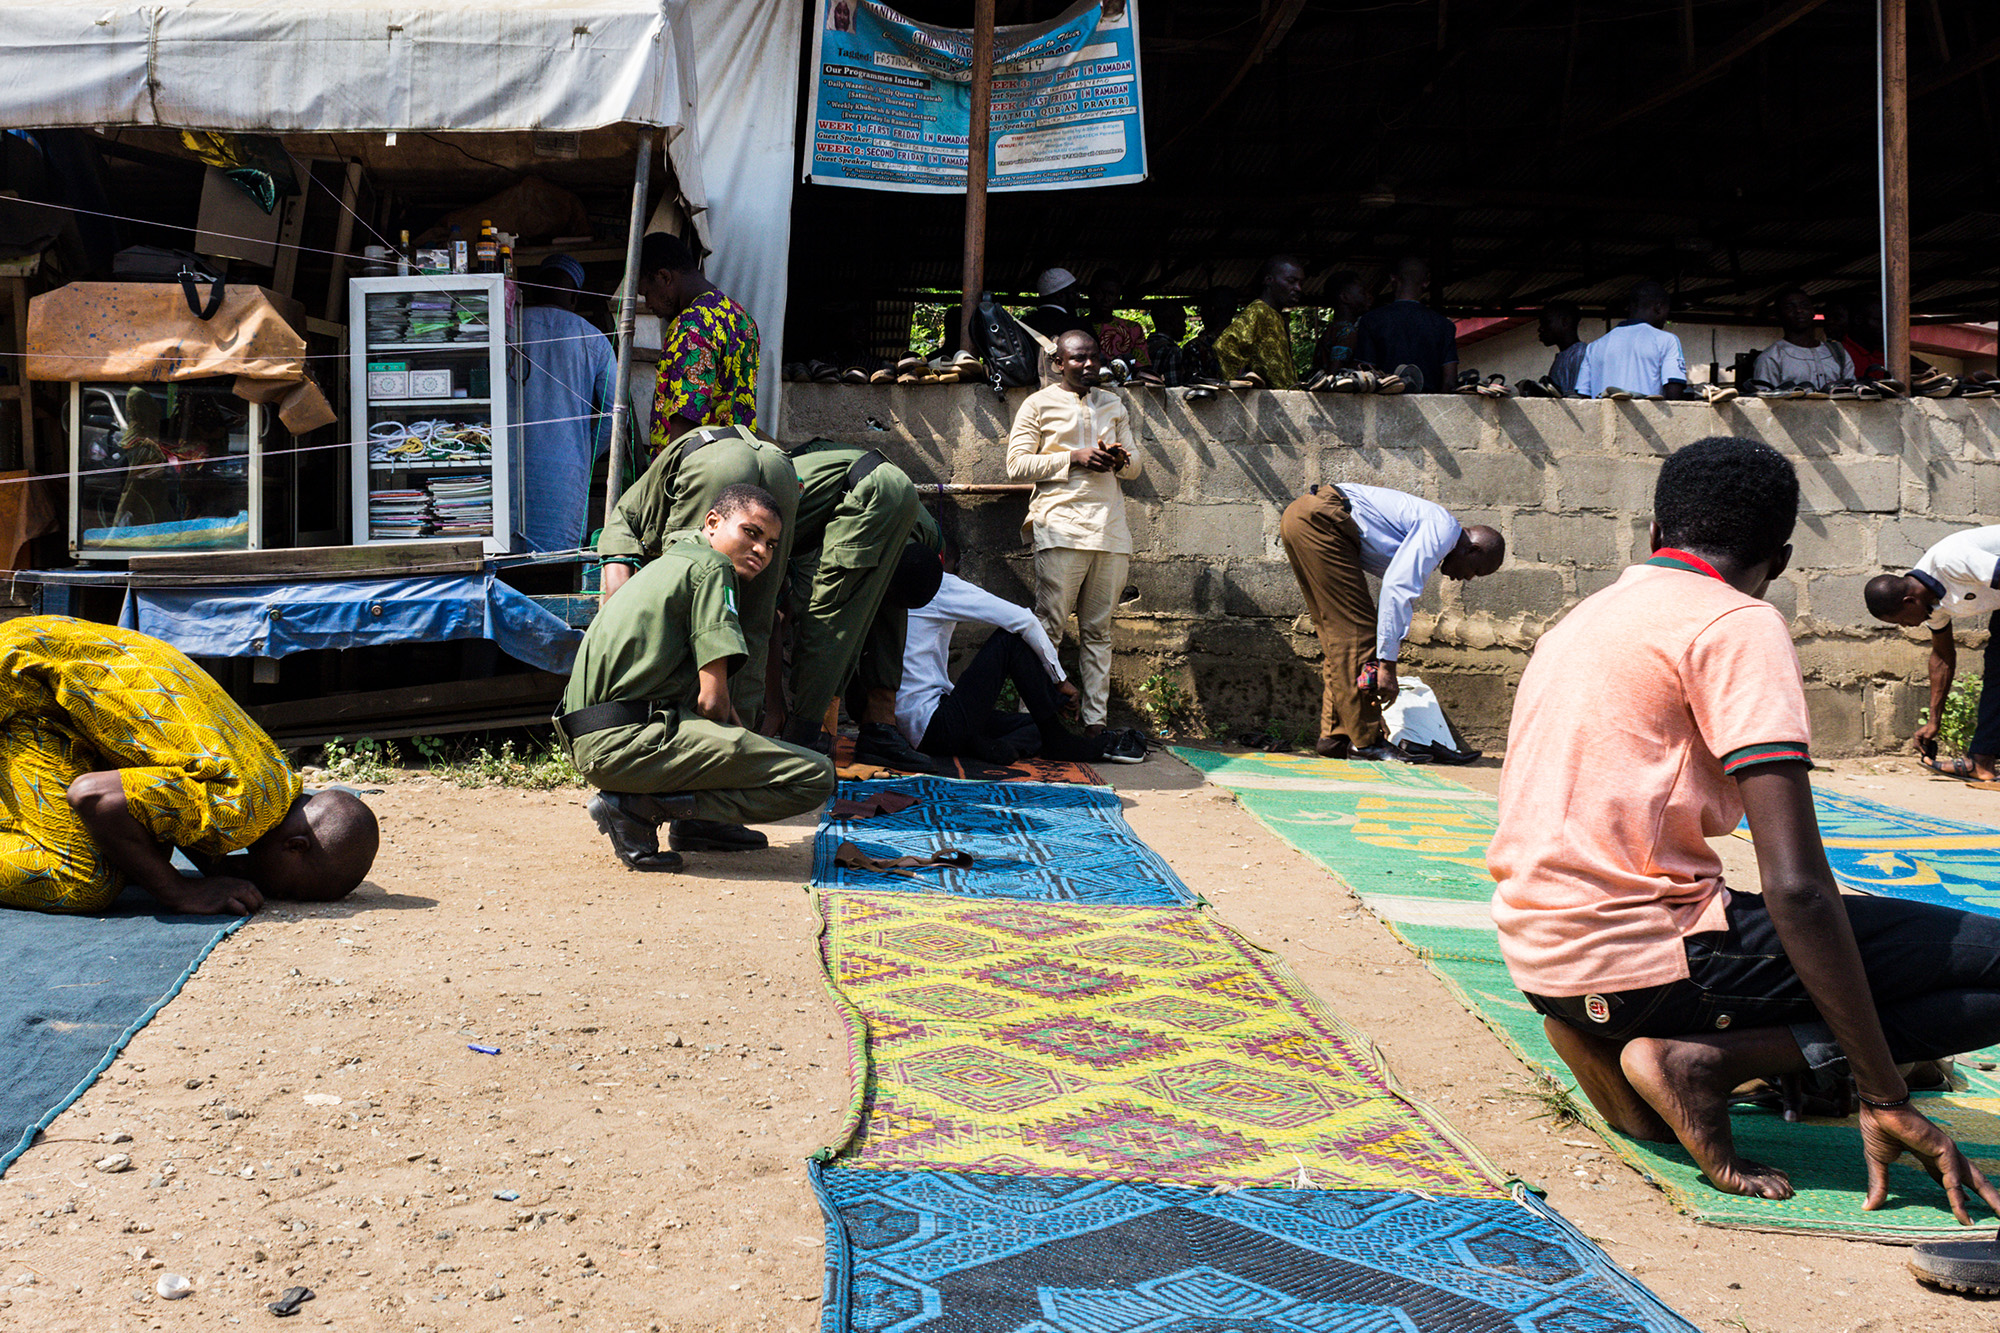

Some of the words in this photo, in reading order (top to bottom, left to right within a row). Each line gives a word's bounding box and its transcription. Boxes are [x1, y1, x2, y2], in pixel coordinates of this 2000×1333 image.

[837, 48, 872, 62] Tagged:
[825, 65, 842, 74] Our
[843, 67, 893, 83] Programmes
[894, 76, 924, 87] Include
[828, 80, 845, 89] Daily
[991, 80, 1018, 89] EEK
[1056, 68, 1080, 82] FRIDAY
[1083, 66, 1093, 75] IN
[1097, 60, 1132, 74] RAMADAN
[990, 102, 1017, 111] EEK
[1029, 97, 1049, 107] LAST
[1050, 91, 1077, 104] FRIDAY
[1081, 89, 1091, 98] IN
[1095, 84, 1128, 97] RAMADAN
[817, 131, 839, 141] Guest
[839, 134, 872, 145] Speaker:
[818, 119, 853, 132] WEEK
[856, 124, 866, 133] 1:
[867, 125, 891, 136] FIRST
[893, 127, 920, 141] FRIDAY
[924, 133, 934, 143] IN
[815, 154, 837, 163] Guest
[838, 157, 870, 166] Speaker:
[816, 142, 852, 154] WEEK
[854, 147, 865, 156] 2:
[866, 147, 895, 159] SECOND
[897, 151, 925, 163] FRIDAY
[928, 154, 938, 164] IN
